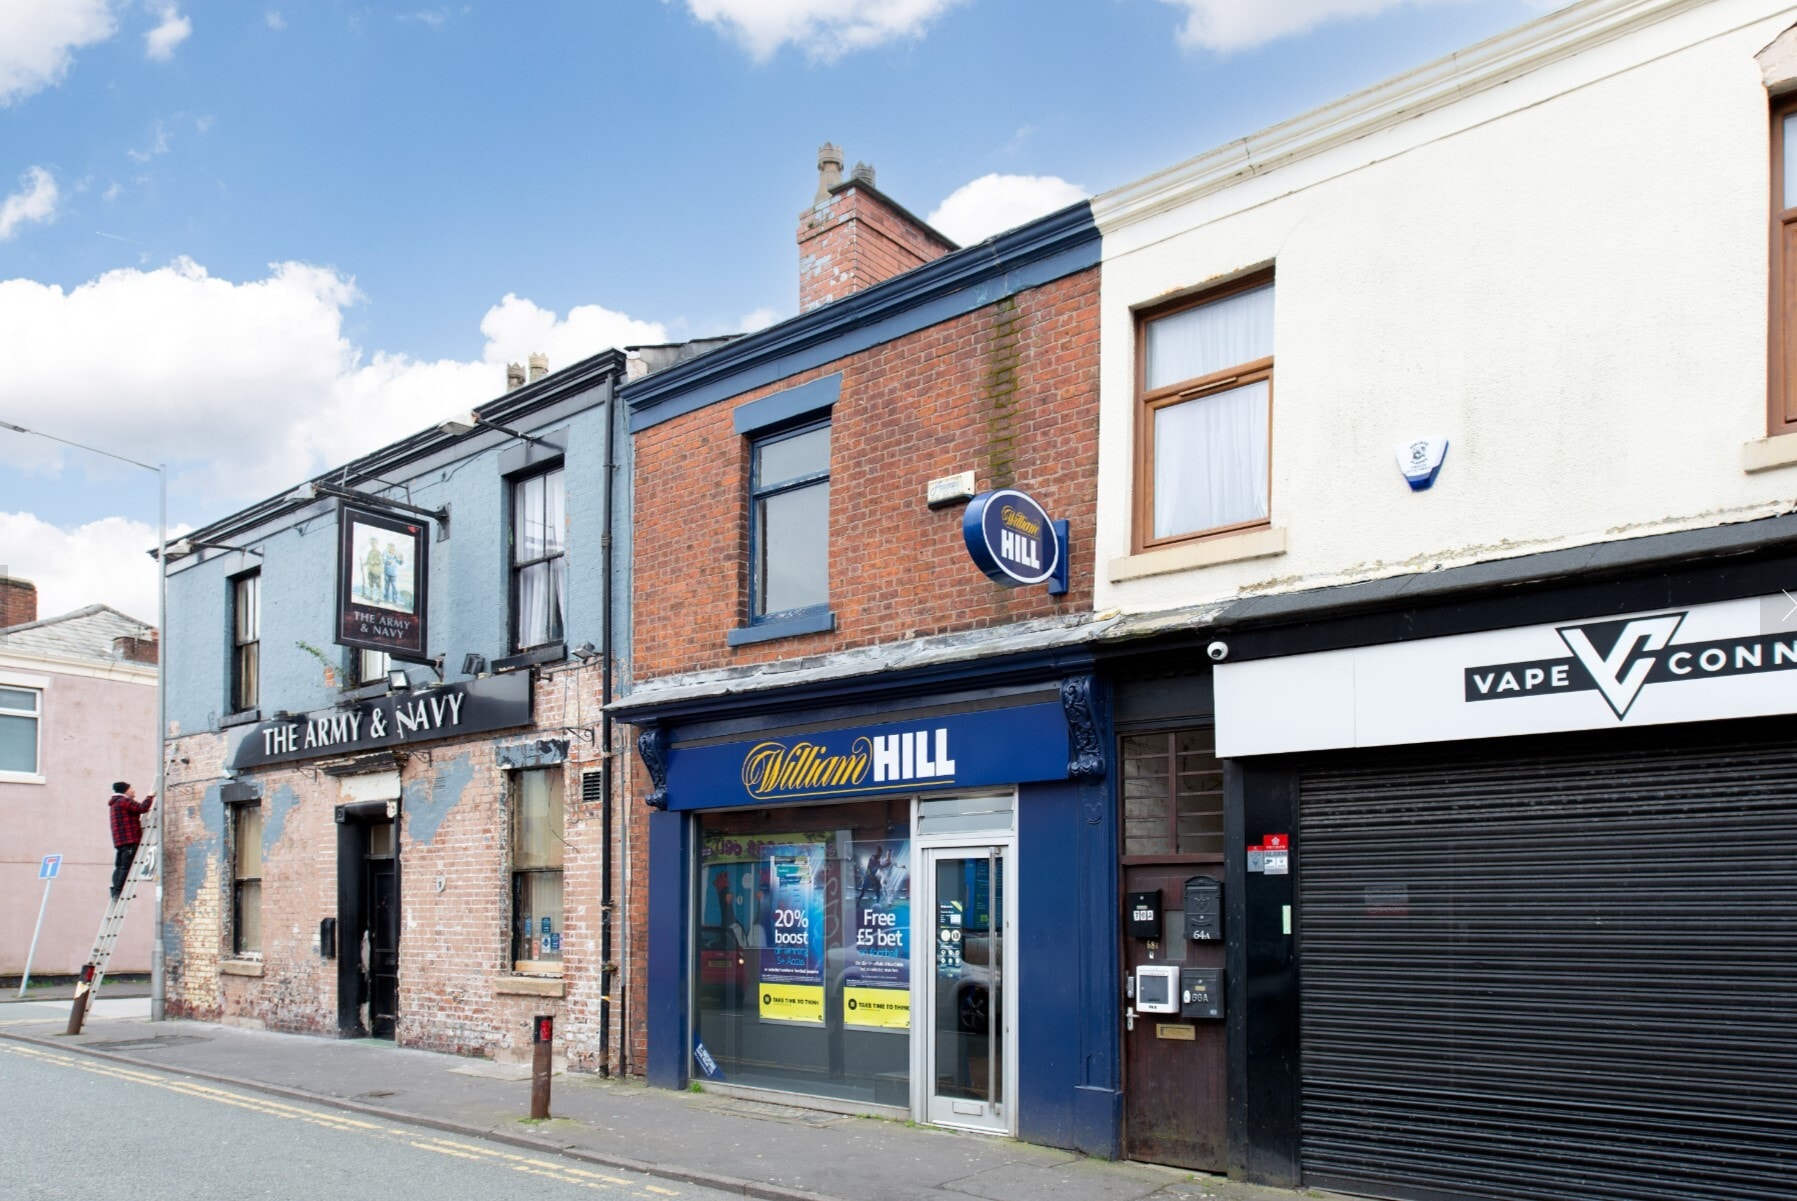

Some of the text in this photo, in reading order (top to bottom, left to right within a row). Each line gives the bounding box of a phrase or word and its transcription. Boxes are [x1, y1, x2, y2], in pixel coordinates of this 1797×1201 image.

[1001, 505, 1040, 536] William
[1001, 529, 1040, 570] HILL
[354, 610, 411, 630] THE ARMY
[360, 622, 405, 639] & NAVY
[1473, 664, 1570, 695] VAPE
[1668, 639, 1797, 675] CONN
[263, 692, 465, 756] THE ARMY & NAVY
[742, 728, 955, 795] William HILL
[774, 909, 809, 928] 20%
[863, 908, 896, 926] Free
[774, 929, 809, 945] boost
[856, 929, 903, 946] £5 bet
[1193, 930, 1211, 940] 64A
